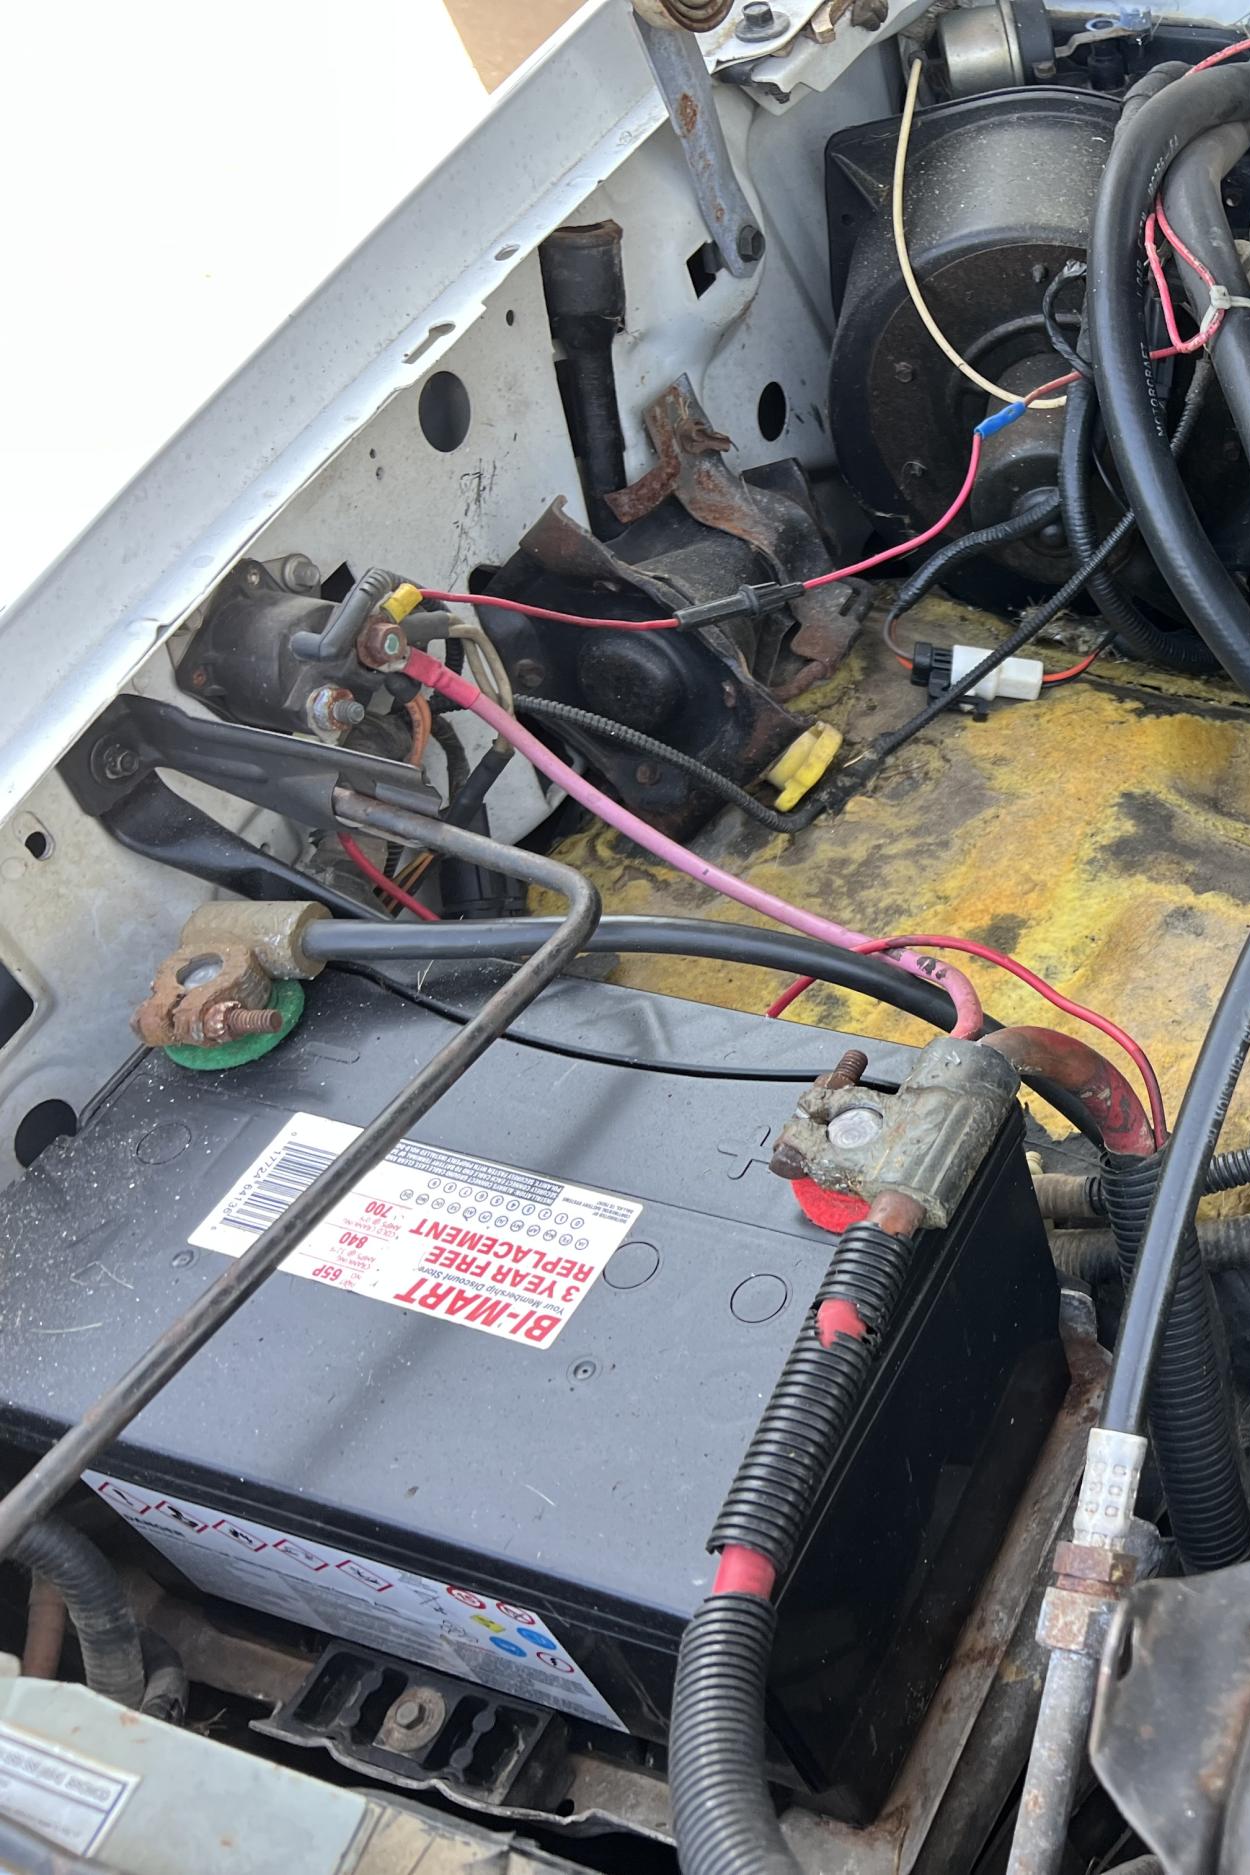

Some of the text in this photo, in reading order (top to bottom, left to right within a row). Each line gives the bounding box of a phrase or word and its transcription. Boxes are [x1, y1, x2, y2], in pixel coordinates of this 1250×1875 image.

[1140, 343, 1164, 437] MOTORCRAFT
[221, 1182, 254, 1214] 64136
[362, 1200, 394, 1218] 700
[336, 1230, 369, 1249] 840
[408, 1216, 595, 1282] REPLACEMENT
[310, 1262, 344, 1281] 65P
[423, 1245, 581, 1303] 3 YEAR FREE
[441, 1273, 485, 1291] Discount
[484, 1284, 544, 1308] Membership
[541, 1302, 565, 1314] Your
[392, 1276, 562, 1342] BI-MART
